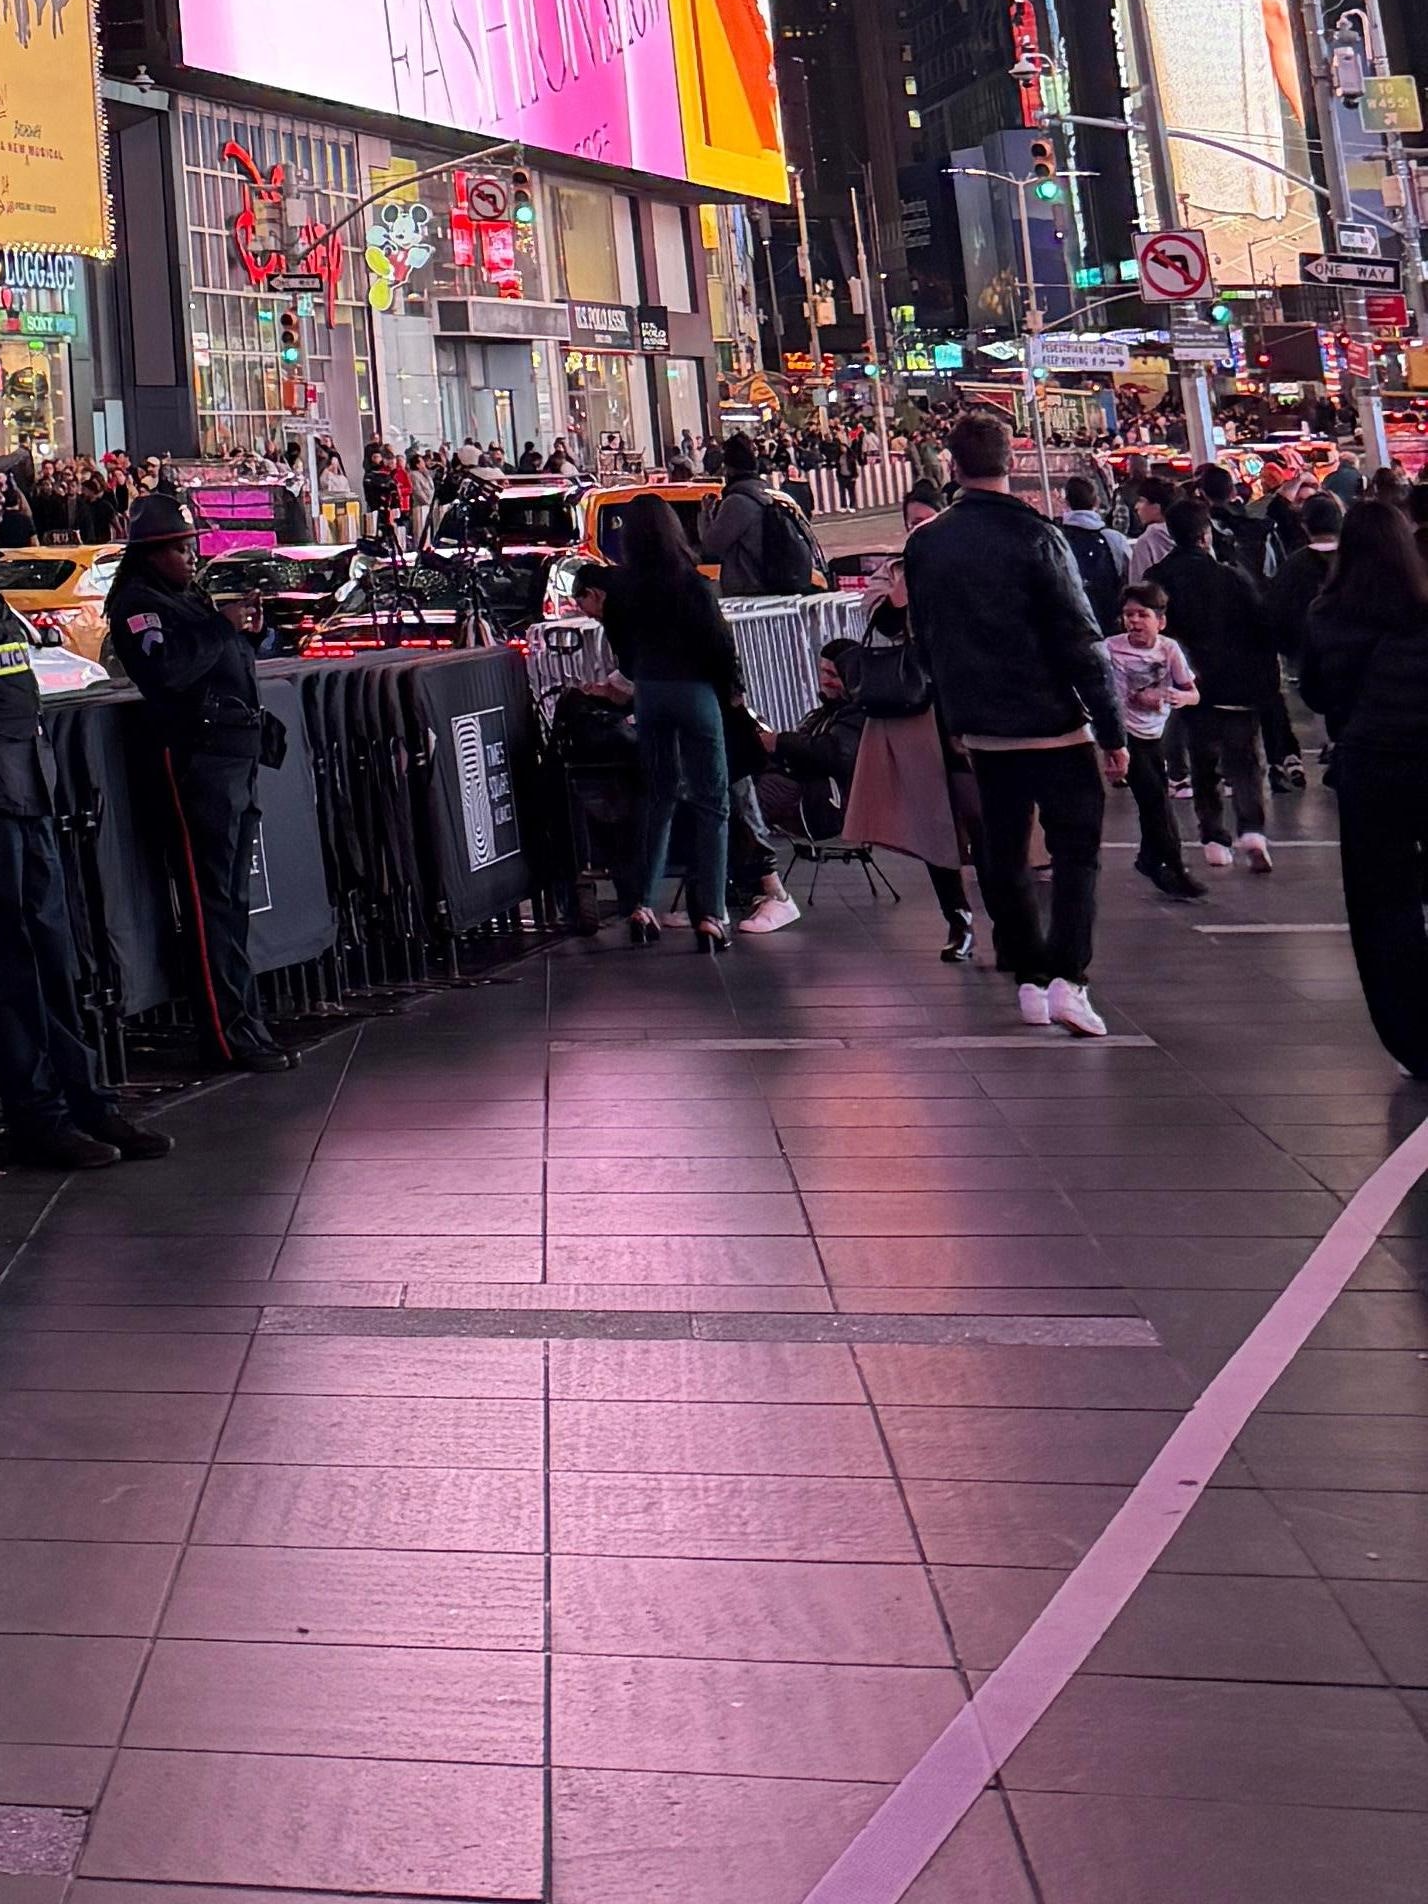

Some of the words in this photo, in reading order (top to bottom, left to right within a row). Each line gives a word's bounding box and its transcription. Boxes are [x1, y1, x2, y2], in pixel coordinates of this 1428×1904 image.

[3, 247, 77, 290] LUGGAGE
[1314, 262, 1343, 276] ONE
[1356, 266, 1388, 280] WAY
[26, 316, 54, 332] SONY
